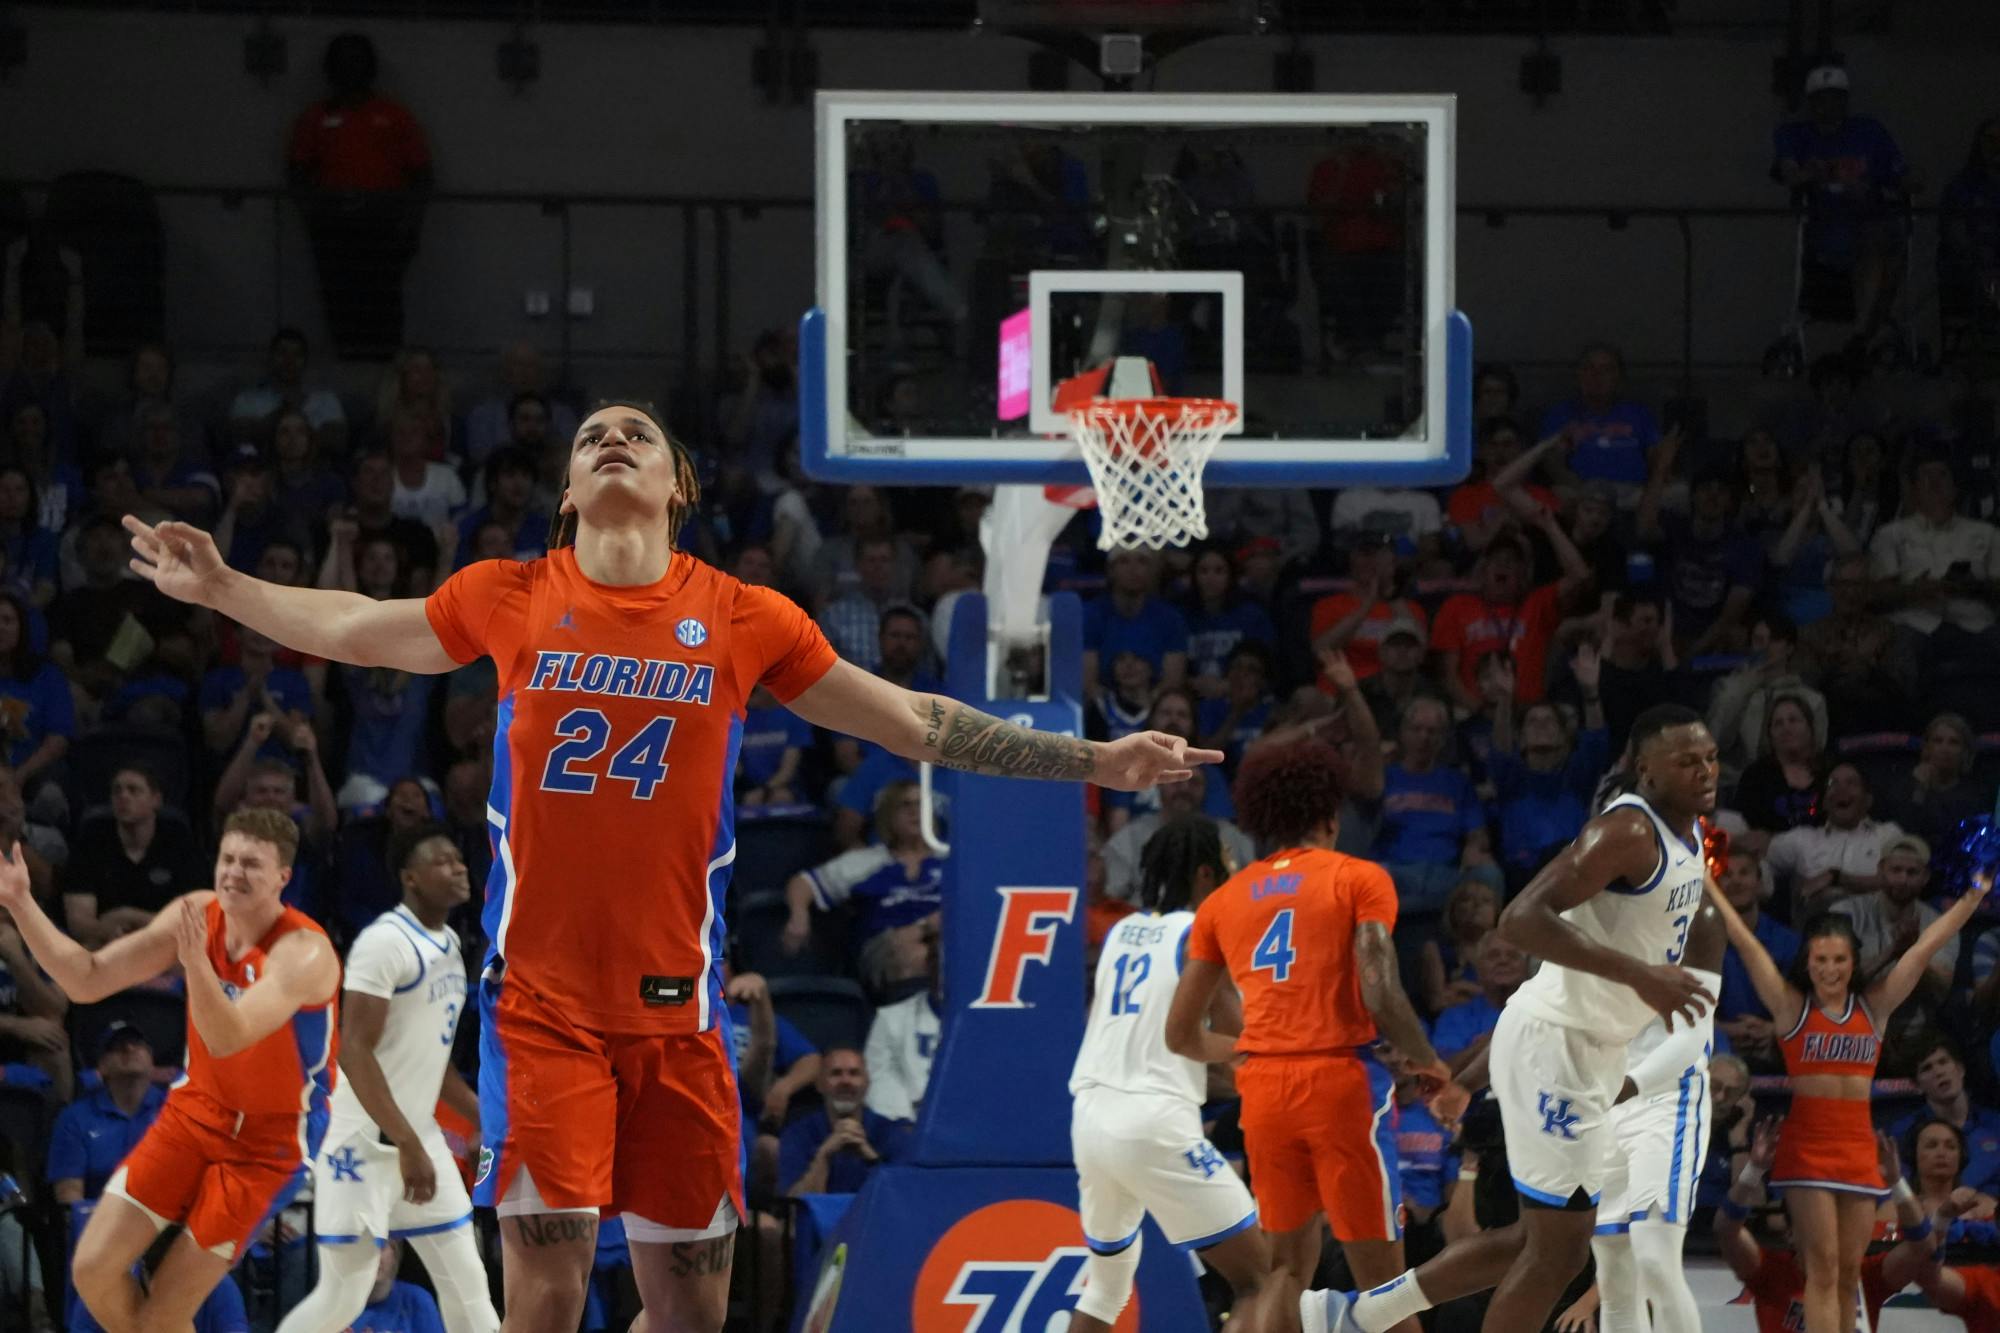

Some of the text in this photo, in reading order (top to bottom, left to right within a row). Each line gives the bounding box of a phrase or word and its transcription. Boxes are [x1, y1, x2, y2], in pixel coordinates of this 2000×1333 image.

[677, 618, 707, 646] SEC
[525, 650, 715, 706] FLORIDA
[539, 707, 677, 801] 24
[967, 886, 1079, 1009] F
[1250, 907, 1297, 984] 4
[1666, 915, 1688, 964] 3
[1111, 953, 1152, 1016] 12
[441, 1003, 456, 1045] 3
[1538, 1090, 1580, 1141] UK
[514, 1214, 597, 1247] Never
[942, 1246, 1094, 1333] 76
